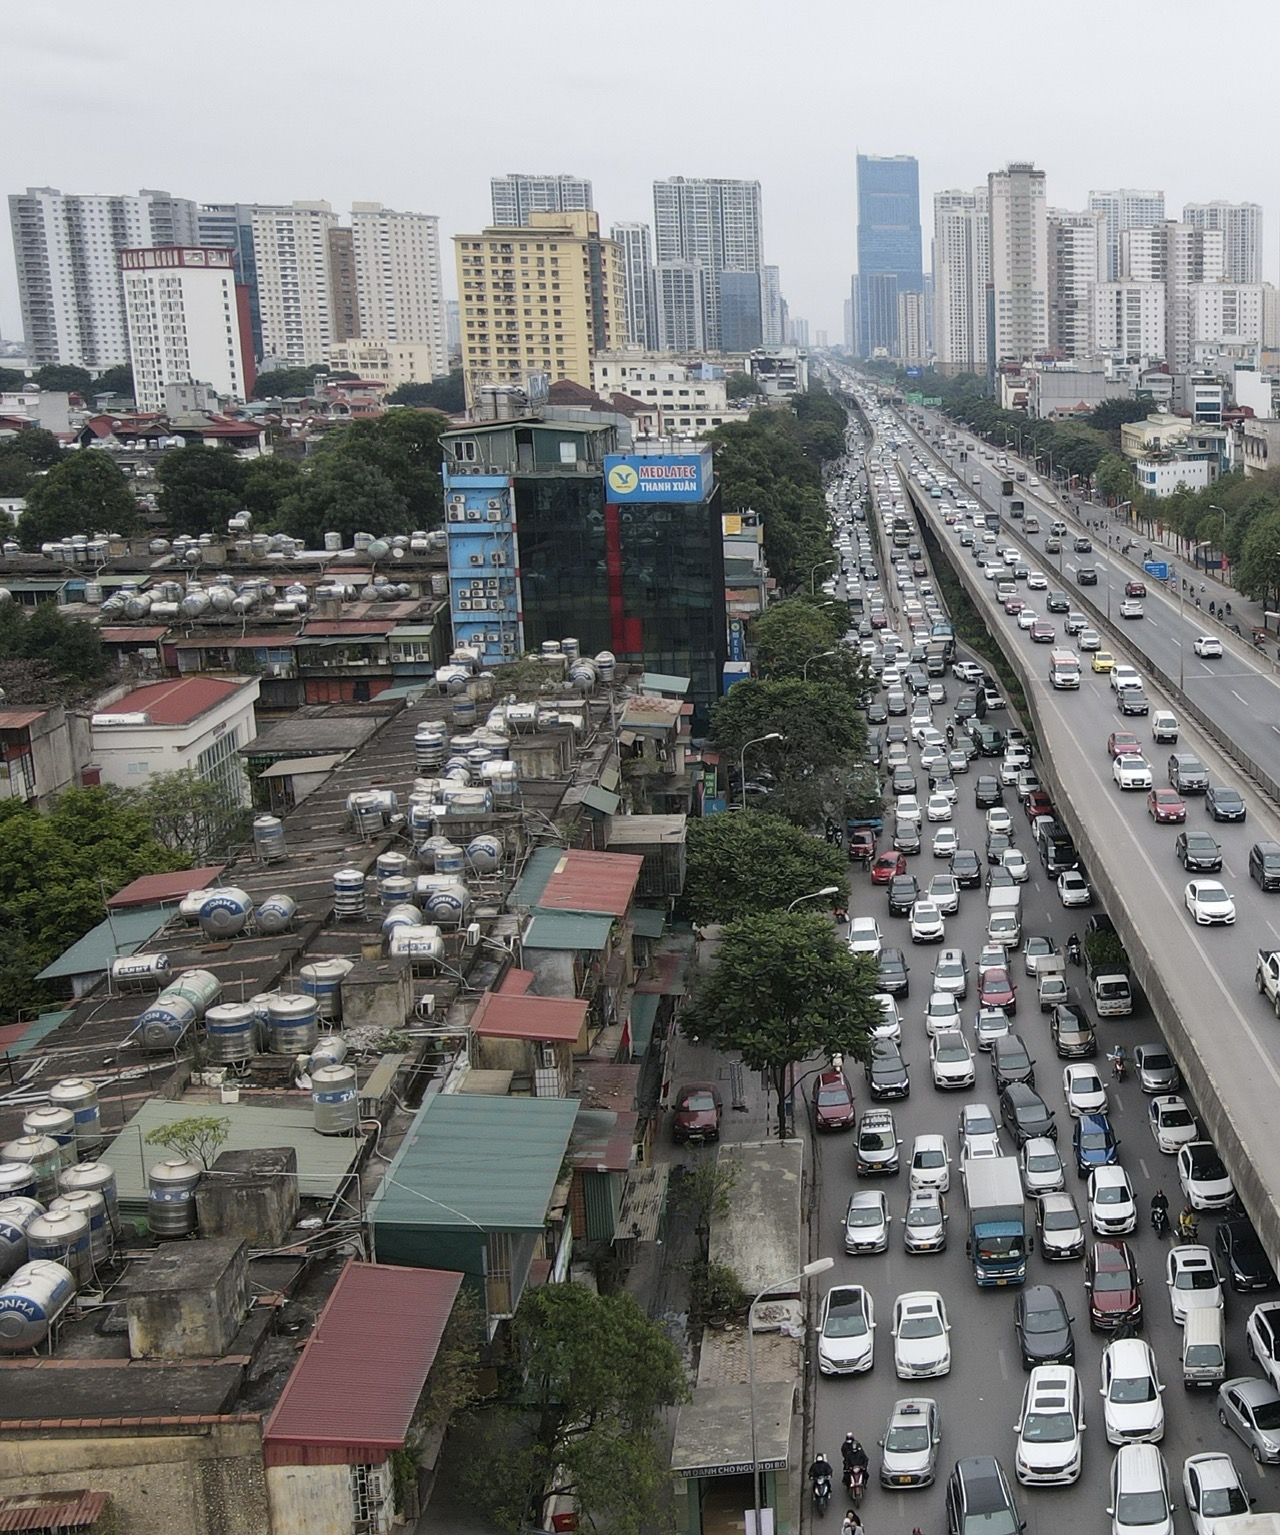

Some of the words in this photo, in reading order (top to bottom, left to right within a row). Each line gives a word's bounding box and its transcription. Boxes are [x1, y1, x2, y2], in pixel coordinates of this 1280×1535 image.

[640, 466, 697, 479] MEDLATEC
[640, 482, 671, 491] THANH
[672, 480, 697, 491] XUÂN
[0, 1300, 34, 1317] ONHA
